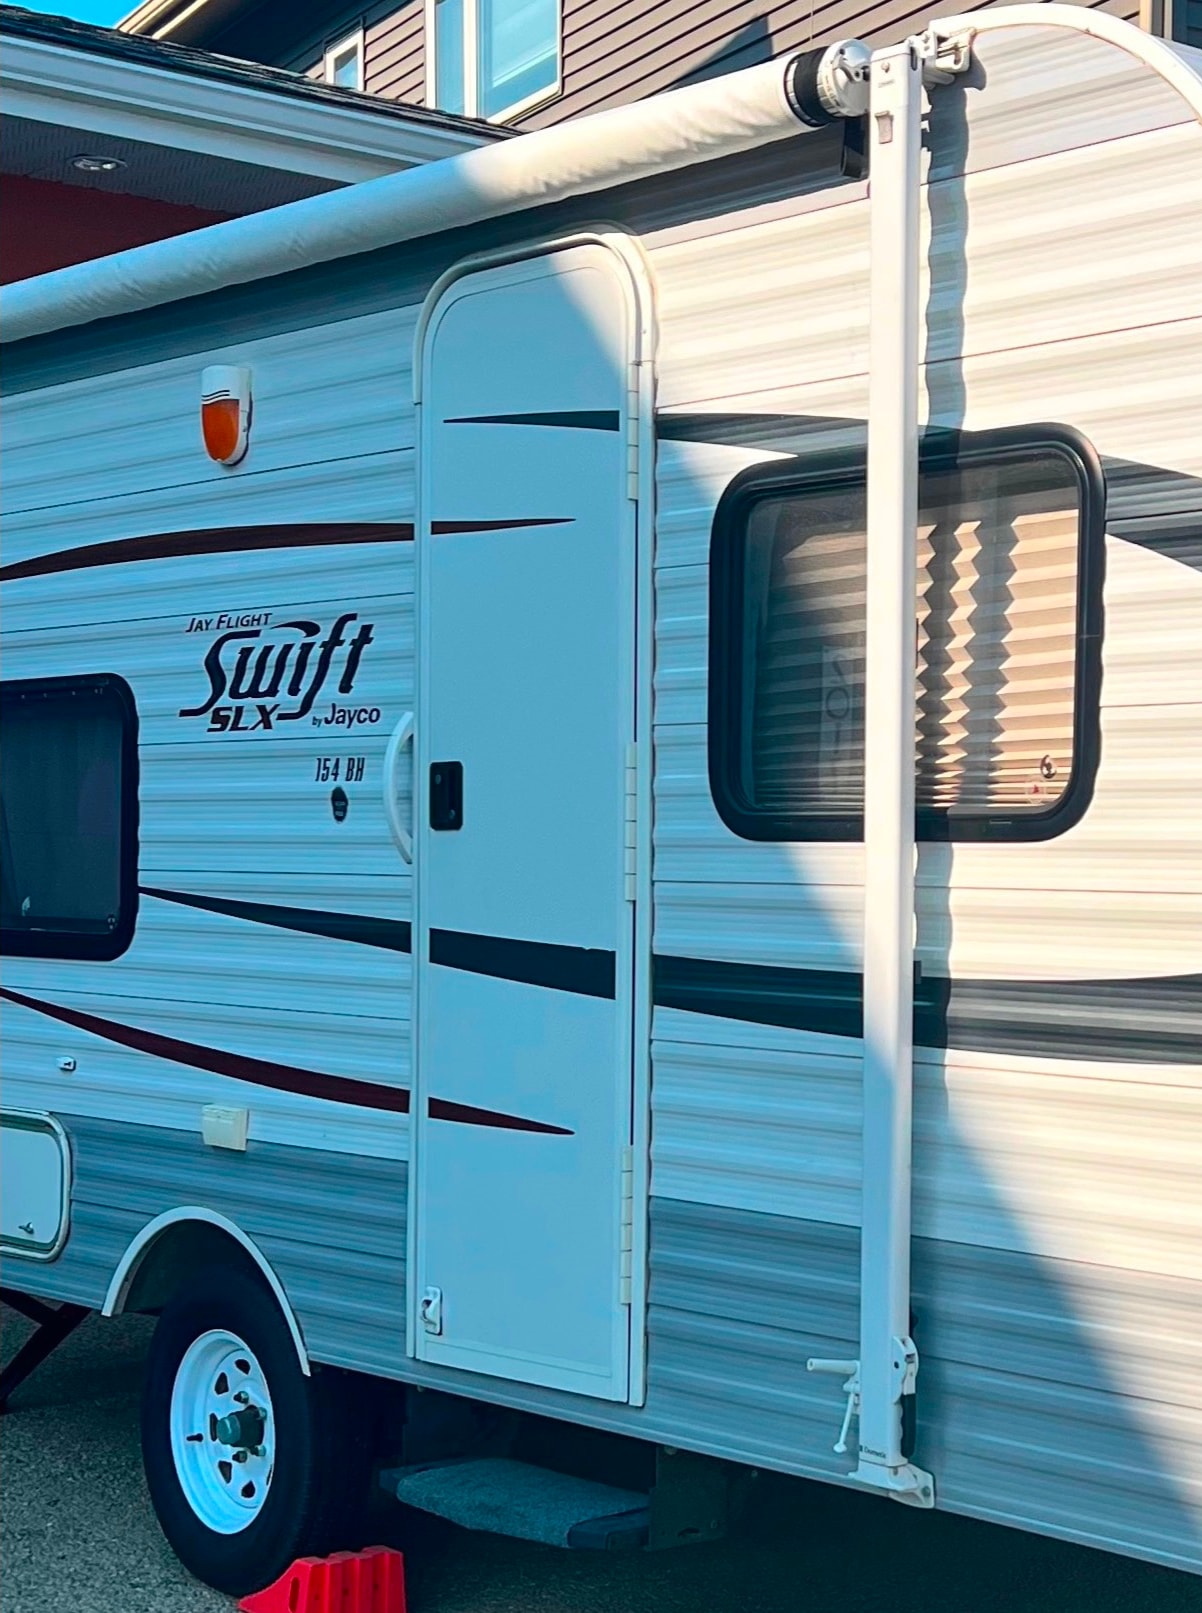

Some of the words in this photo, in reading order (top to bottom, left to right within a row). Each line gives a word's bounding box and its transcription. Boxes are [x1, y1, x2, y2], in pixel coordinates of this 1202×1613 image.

[185, 617, 213, 633] JAY
[216, 612, 273, 630] FLIGHT
[178, 612, 375, 721] Swift
[206, 703, 281, 733] SLX
[312, 715, 323, 728] by
[323, 702, 381, 729] Jayco
[314, 757, 341, 782] 154
[345, 757, 365, 782] BH
